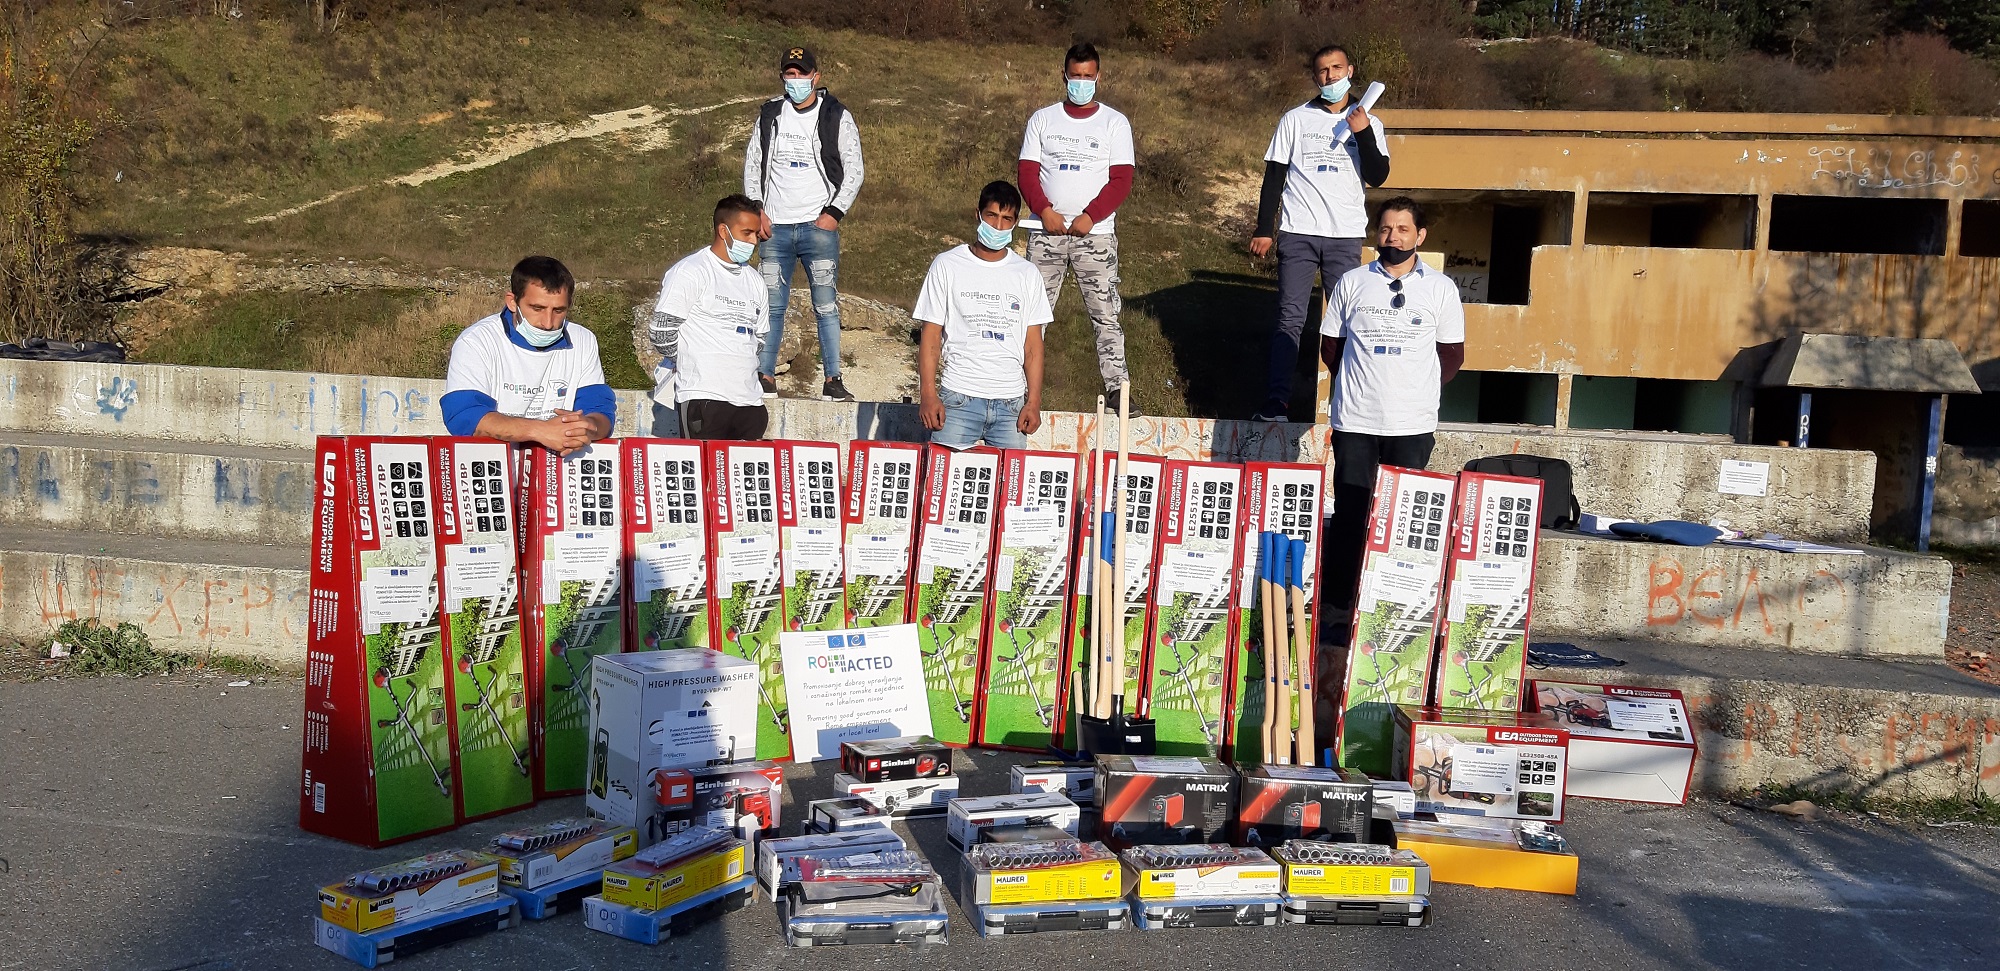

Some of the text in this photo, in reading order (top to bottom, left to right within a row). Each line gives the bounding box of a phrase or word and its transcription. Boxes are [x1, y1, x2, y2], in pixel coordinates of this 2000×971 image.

[323, 452, 336, 497] LEA
[522, 449, 532, 487] LEA
[378, 464, 394, 538] LE25517BP
[461, 463, 474, 532] LE25517BP
[654, 462, 665, 523] LE25517BP
[734, 464, 744, 522] LE25517BP
[798, 462, 808, 518] LE25517BP
[868, 463, 880, 516] LE25517BP
[948, 468, 961, 521] LE25517BP
[547, 496, 558, 527] LEA
[635, 496, 646, 524] LEA
[718, 496, 728, 524] LEA
[783, 493, 792, 519] LEA
[850, 492, 861, 516] LEA
[929, 496, 941, 520] LEA
[1188, 482, 1198, 537] LE25517BP
[359, 506, 373, 540] LEA
[444, 502, 456, 535] LEA
[1168, 511, 1179, 536] LEA
[1395, 490, 1410, 546] LE25517BP
[1483, 496, 1496, 554] LE25517BP
[320, 499, 329, 573] EQUIPMENT
[1374, 519, 1387, 545] LEA
[1461, 527, 1472, 553] LEA
[604, 668, 623, 682] PRESSURE
[623, 676, 639, 687] WASHER
[648, 672, 754, 689] HIGH PRESSURE WASHER
[803, 676, 902, 690] Promovisanje dobrog upravljanja
[850, 687, 872, 696] romske
[874, 684, 904, 694] zajednice
[807, 714, 838, 723] Promoting
[839, 710, 854, 719] good
[856, 707, 892, 718] governance
[846, 717, 892, 728] empowerment
[1494, 731, 1518, 741] LEA
[881, 758, 916, 768] Einhell
[696, 779, 740, 790] Einhell
[1186, 782, 1229, 793] MATRIX
[1322, 791, 1368, 802] MATRIX
[662, 876, 683, 889] MAURER
